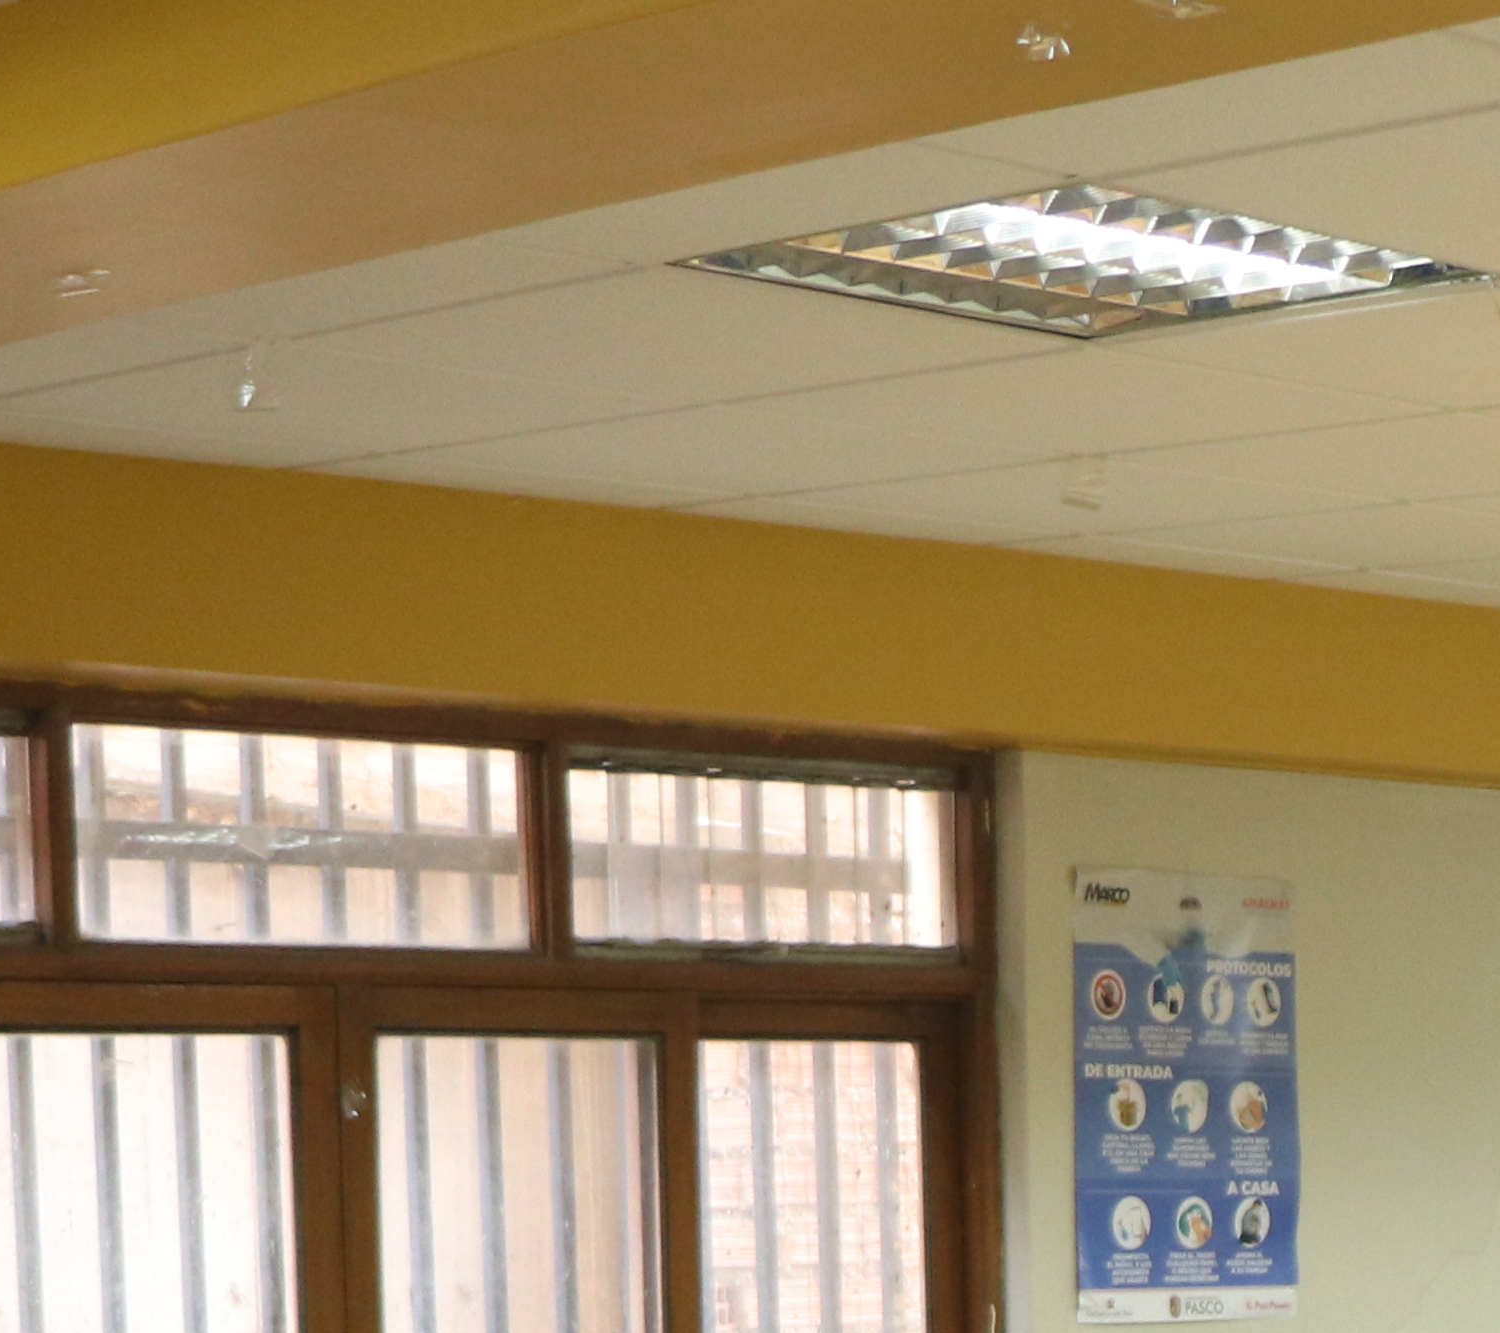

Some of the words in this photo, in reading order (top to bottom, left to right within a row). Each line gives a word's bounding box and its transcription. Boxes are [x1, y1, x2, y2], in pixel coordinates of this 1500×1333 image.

[1206, 960, 1292, 977] PROTOCOLOS
[1084, 1063, 1105, 1078] DE
[1107, 1064, 1174, 1080] ENTRADA
[1227, 1180, 1239, 1196] A
[1241, 1180, 1280, 1196] CASA
[1184, 1299, 1224, 1315] PASCO
